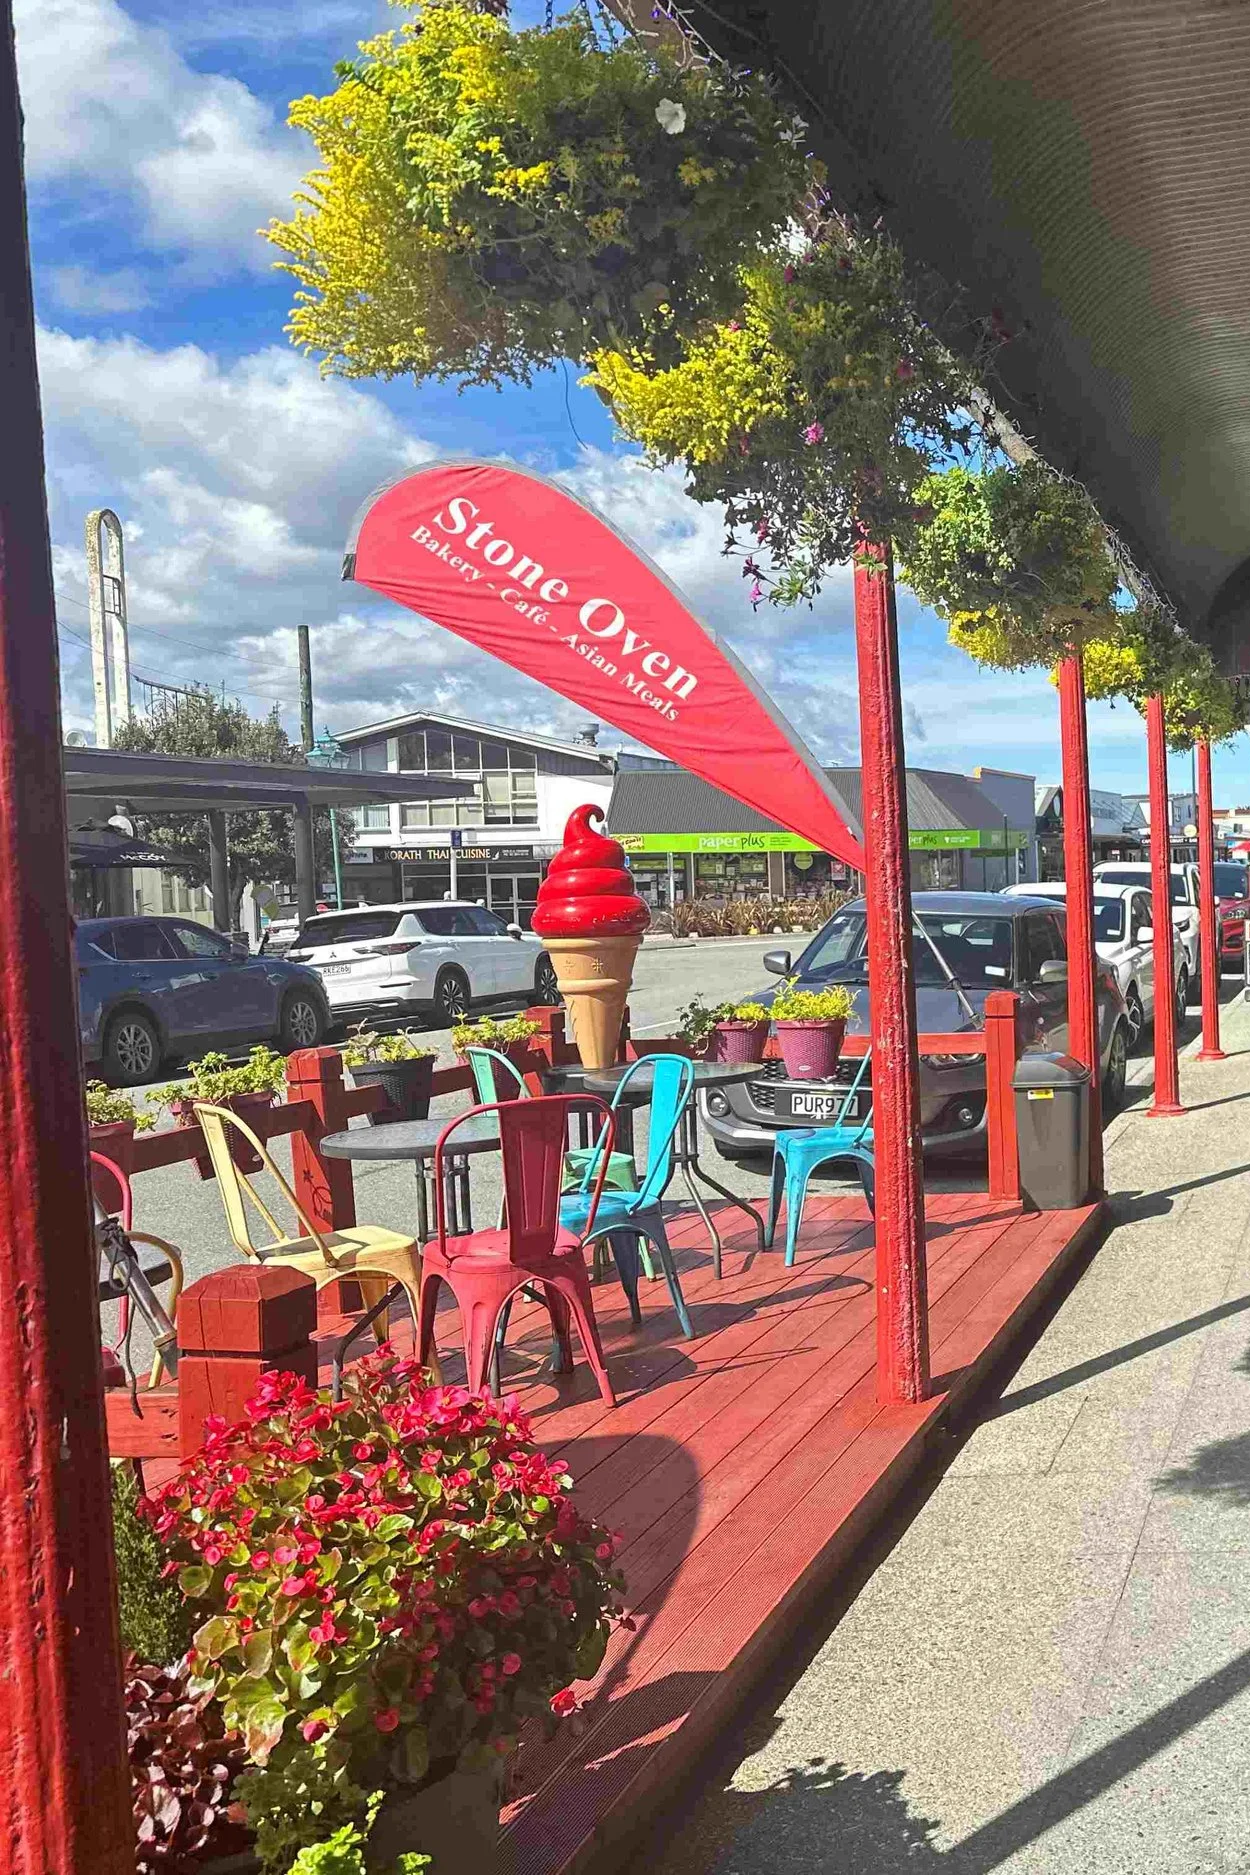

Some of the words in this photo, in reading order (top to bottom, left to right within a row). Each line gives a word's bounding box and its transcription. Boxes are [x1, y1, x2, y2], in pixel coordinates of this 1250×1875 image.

[433, 497, 570, 604] Stone
[578, 597, 700, 702] Oven
[409, 525, 486, 584] Bakery
[500, 586, 549, 632] Café
[559, 632, 618, 680] Asian
[619, 673, 681, 723] Meals
[698, 835, 739, 849] paper
[740, 832, 766, 850] plus
[426, 849, 450, 860] THAI
[455, 848, 492, 860] CUISINE
[794, 1096, 856, 1114] PUR977
